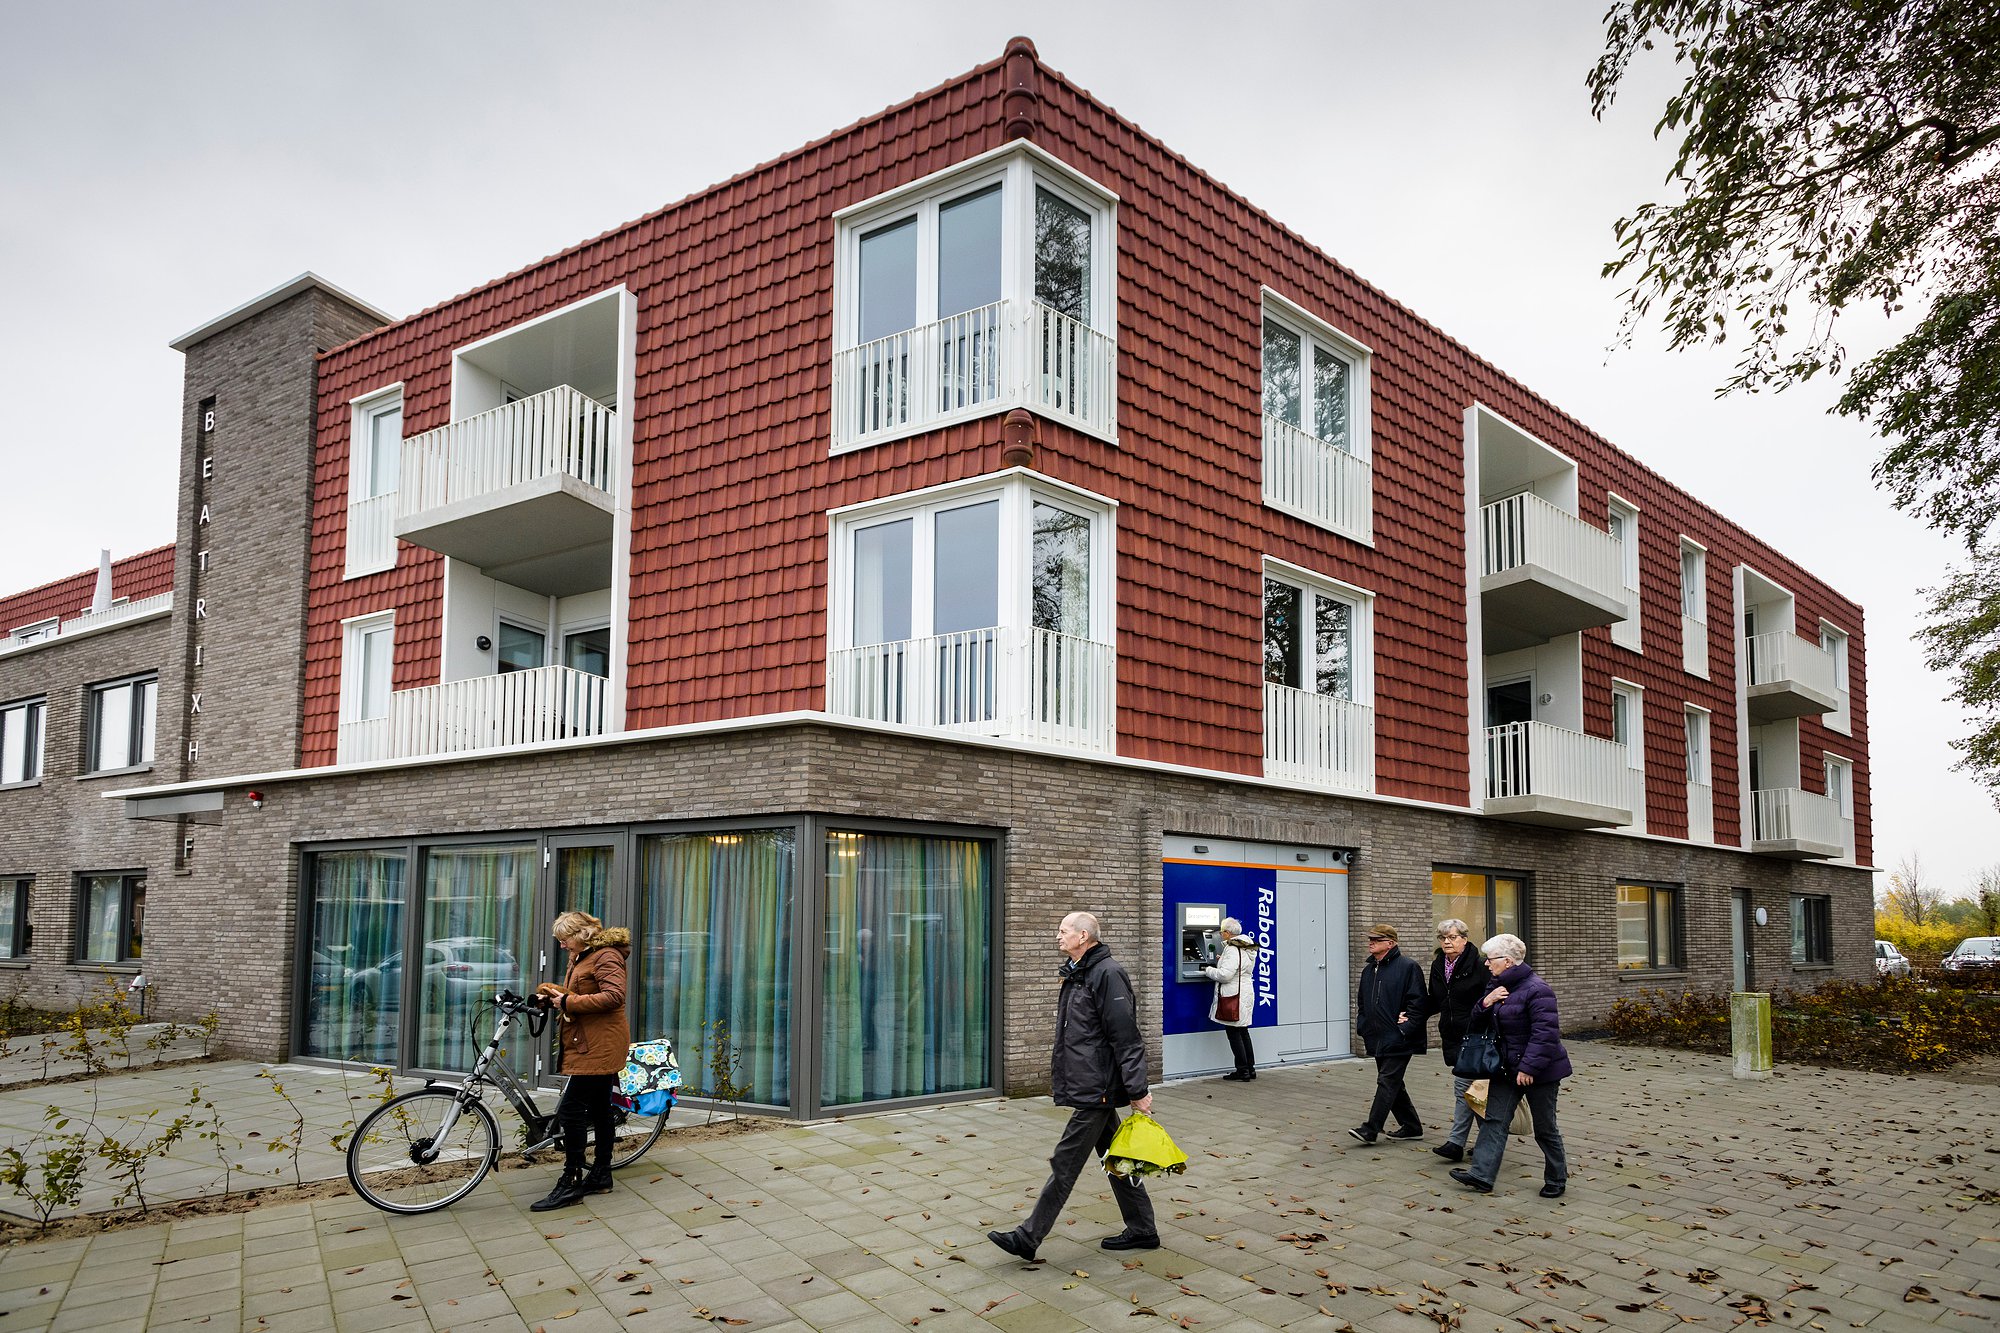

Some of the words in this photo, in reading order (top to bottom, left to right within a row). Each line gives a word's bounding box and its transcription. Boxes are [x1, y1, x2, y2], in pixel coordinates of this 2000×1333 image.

[183, 411, 215, 858] BEATRIXHF
[1258, 887, 1275, 1007] Rabobank
[494, 1074, 520, 1102] GAZELLE
